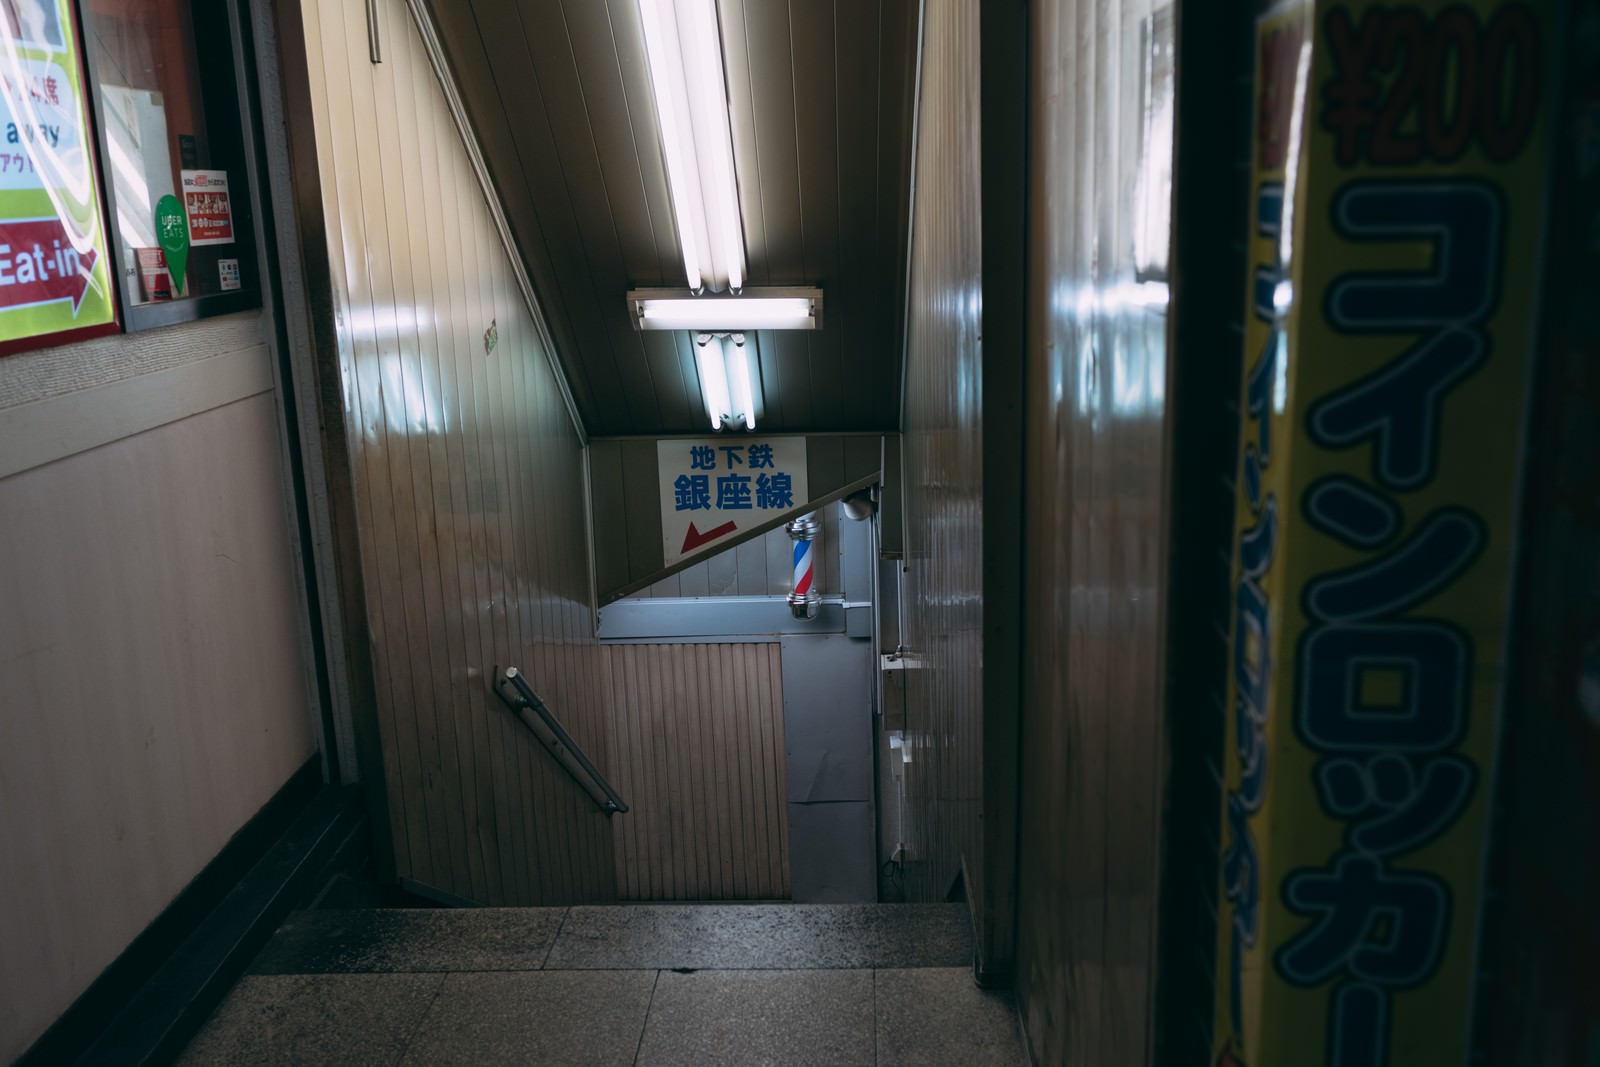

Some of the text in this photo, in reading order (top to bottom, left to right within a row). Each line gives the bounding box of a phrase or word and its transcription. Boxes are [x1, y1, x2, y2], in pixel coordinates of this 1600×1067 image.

[1321, 3, 1540, 166] ¥200
[161, 215, 182, 226] UBER
[163, 228, 184, 238] EATS
[0, 242, 82, 286] Eat-in
[690, 443, 775, 470] 地下鉄
[674, 472, 794, 511] 銀座線
[1277, 178, 1507, 1067] コインロッカー
